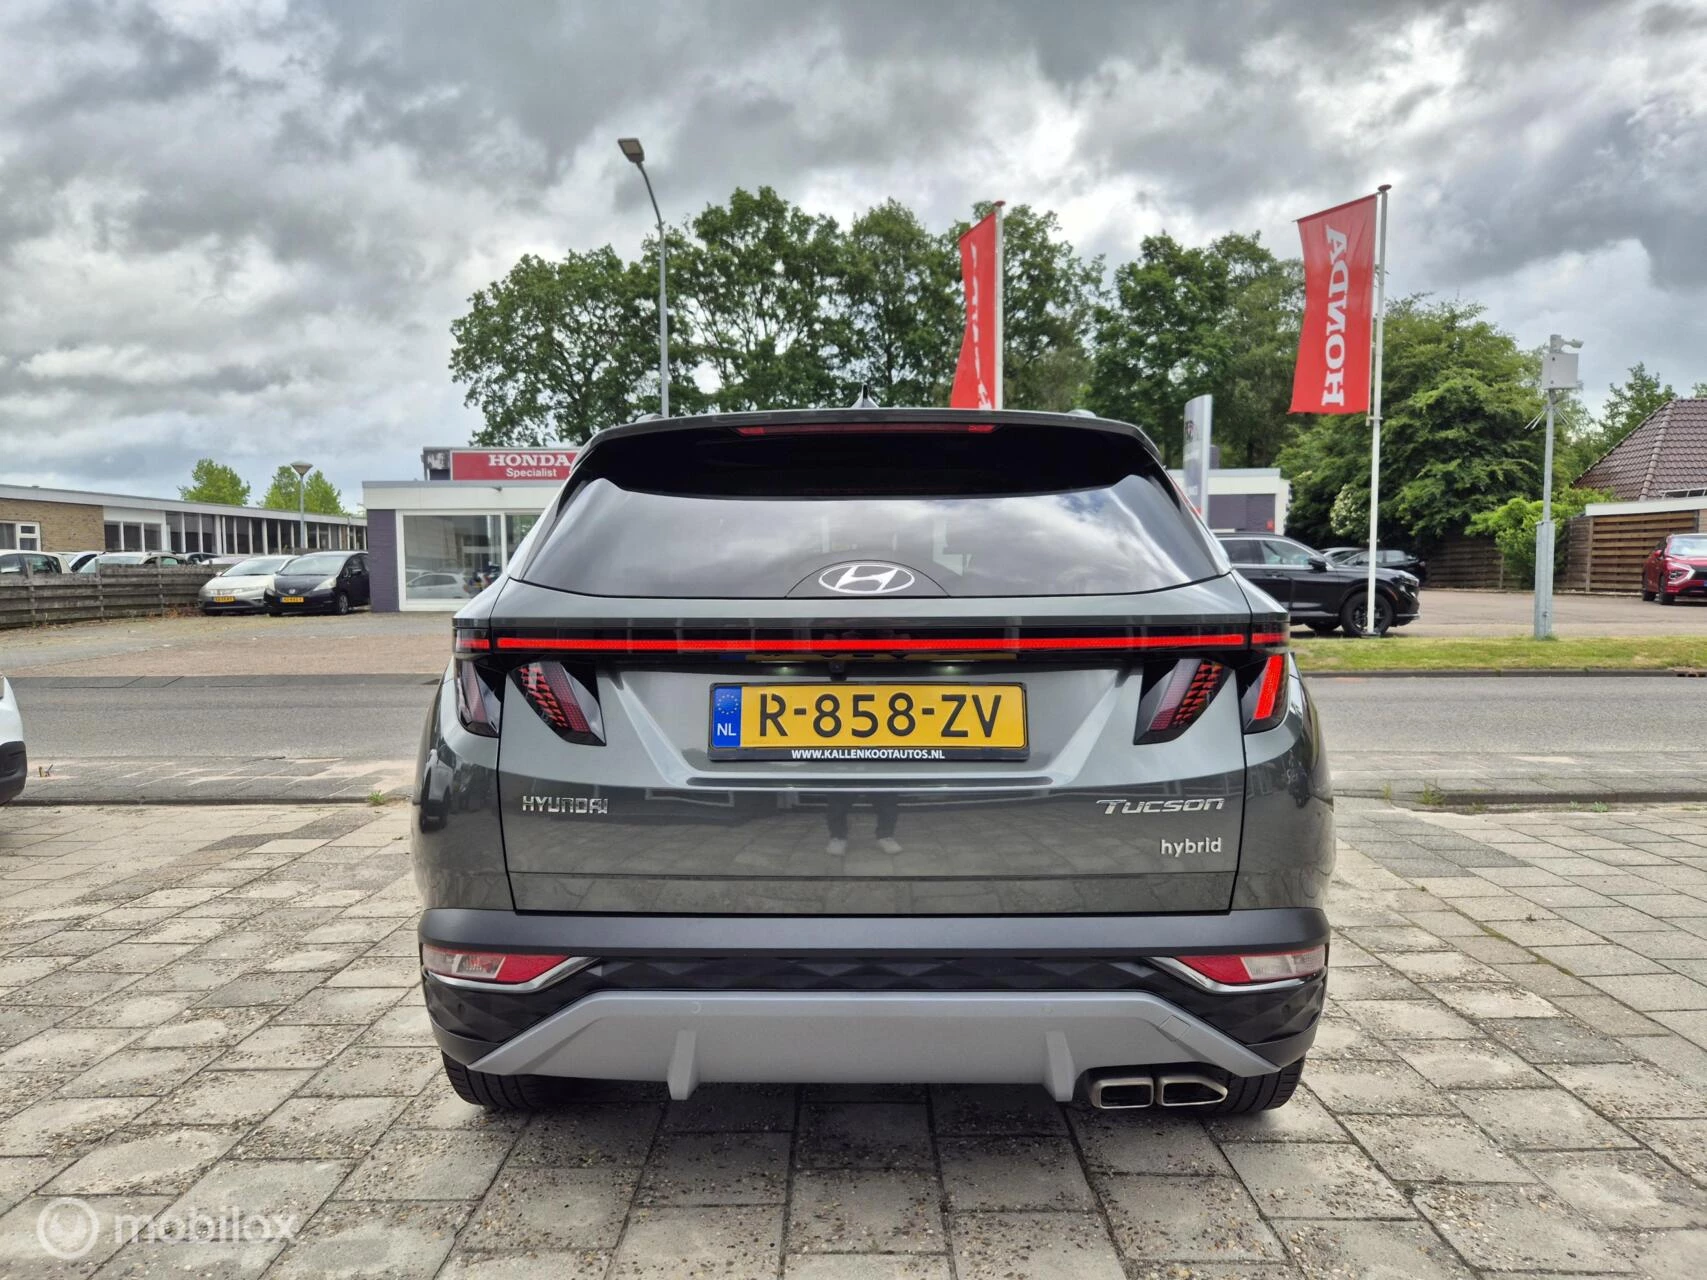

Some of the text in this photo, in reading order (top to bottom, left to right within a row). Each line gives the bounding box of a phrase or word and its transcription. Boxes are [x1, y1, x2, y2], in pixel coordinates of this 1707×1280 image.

[488, 454, 571, 467] HONDA
[506, 468, 557, 478] Specialist
[759, 692, 1002, 738] R-858-ZV
[716, 722, 737, 737] NL
[791, 749, 945, 760] WWW.KALLENKOOTAUTOS.NL
[522, 795, 609, 814] HYUNDAI
[1161, 837, 1222, 857] hybrid
